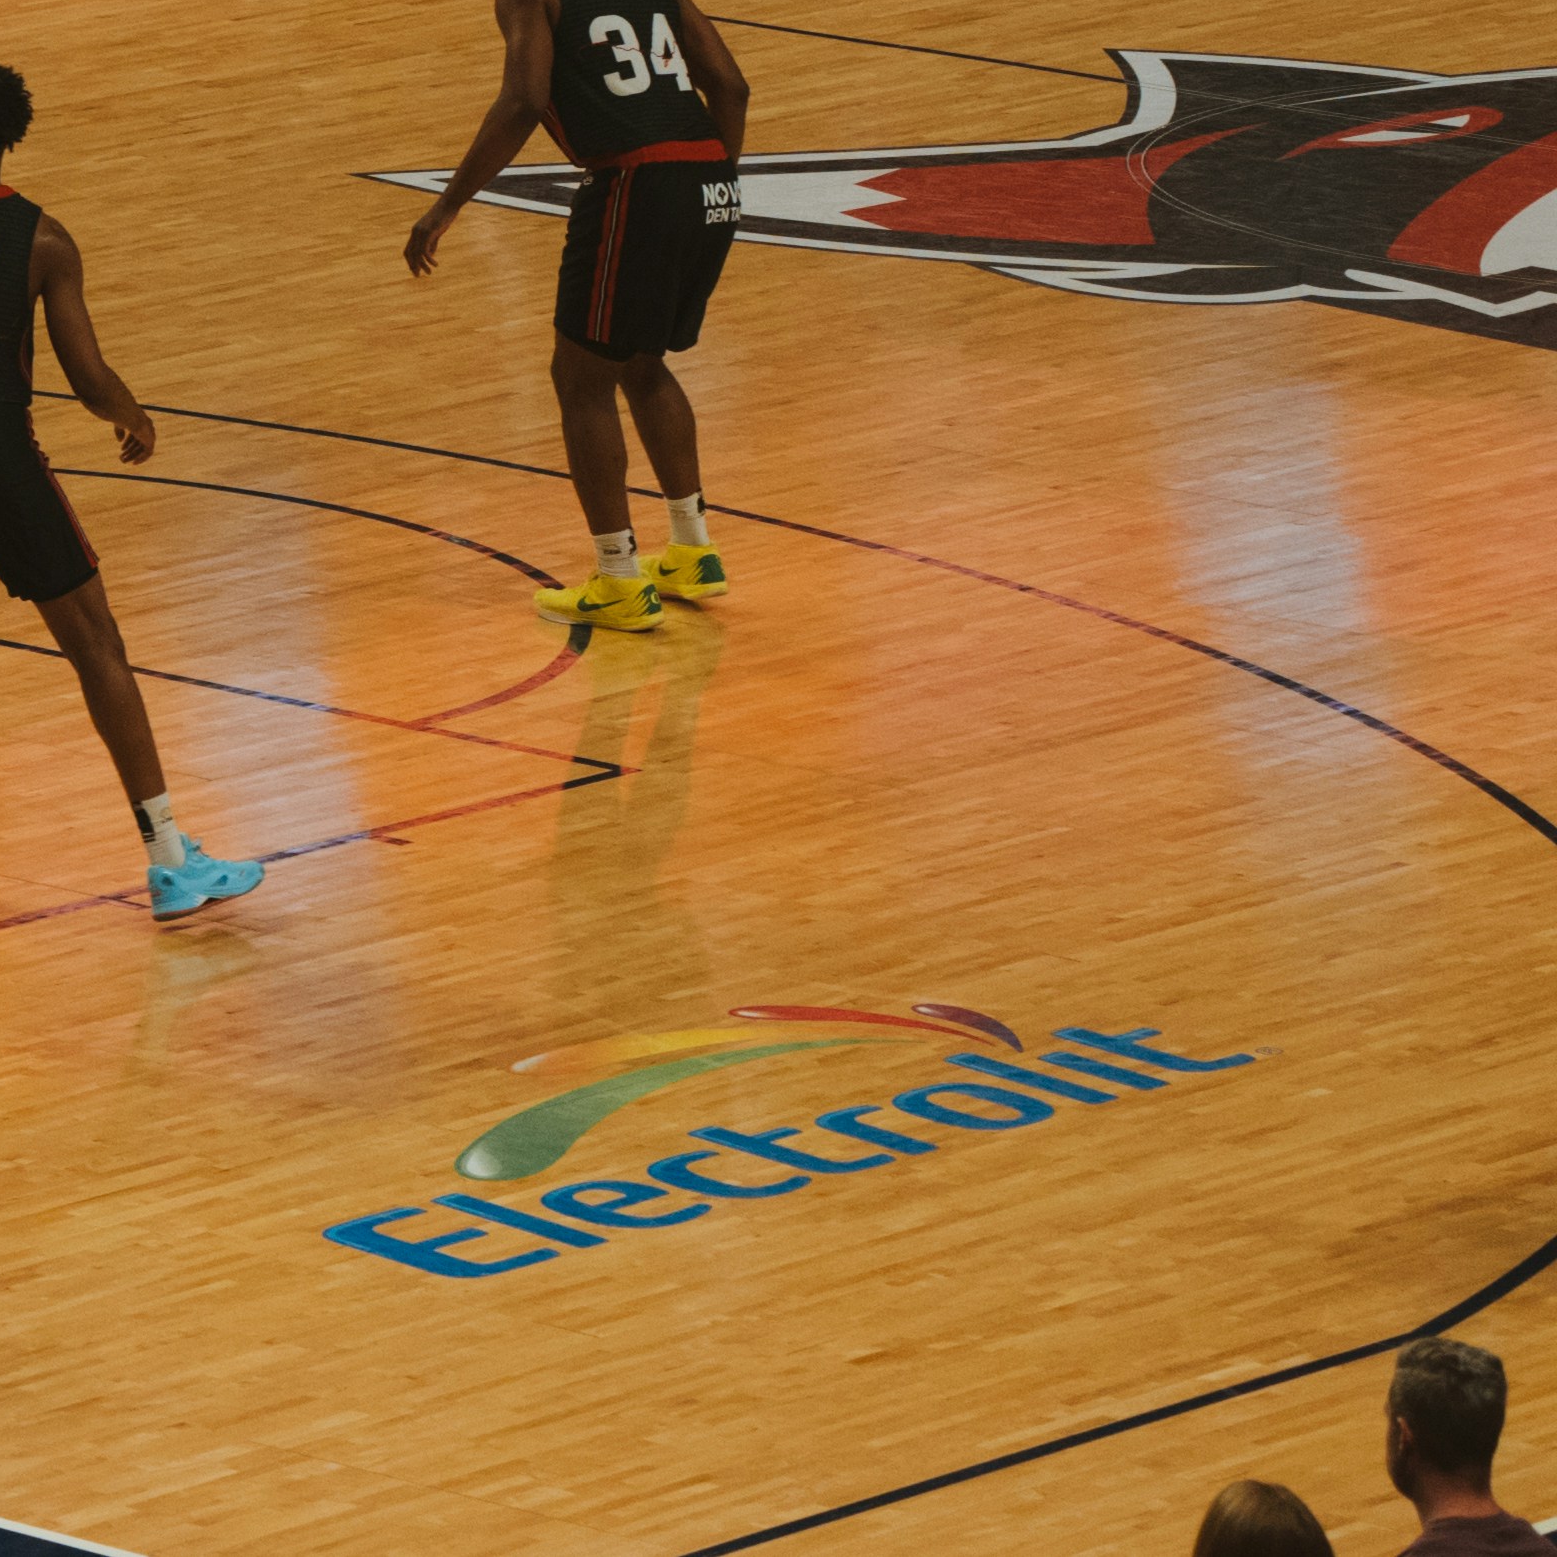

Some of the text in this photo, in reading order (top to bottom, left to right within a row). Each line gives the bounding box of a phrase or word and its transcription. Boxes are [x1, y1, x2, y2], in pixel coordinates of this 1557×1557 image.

[588, 12, 694, 97] 34
[701, 180, 742, 208] NOV
[705, 205, 742, 225] DENTA
[322, 1025, 1257, 1279] Electrolit
